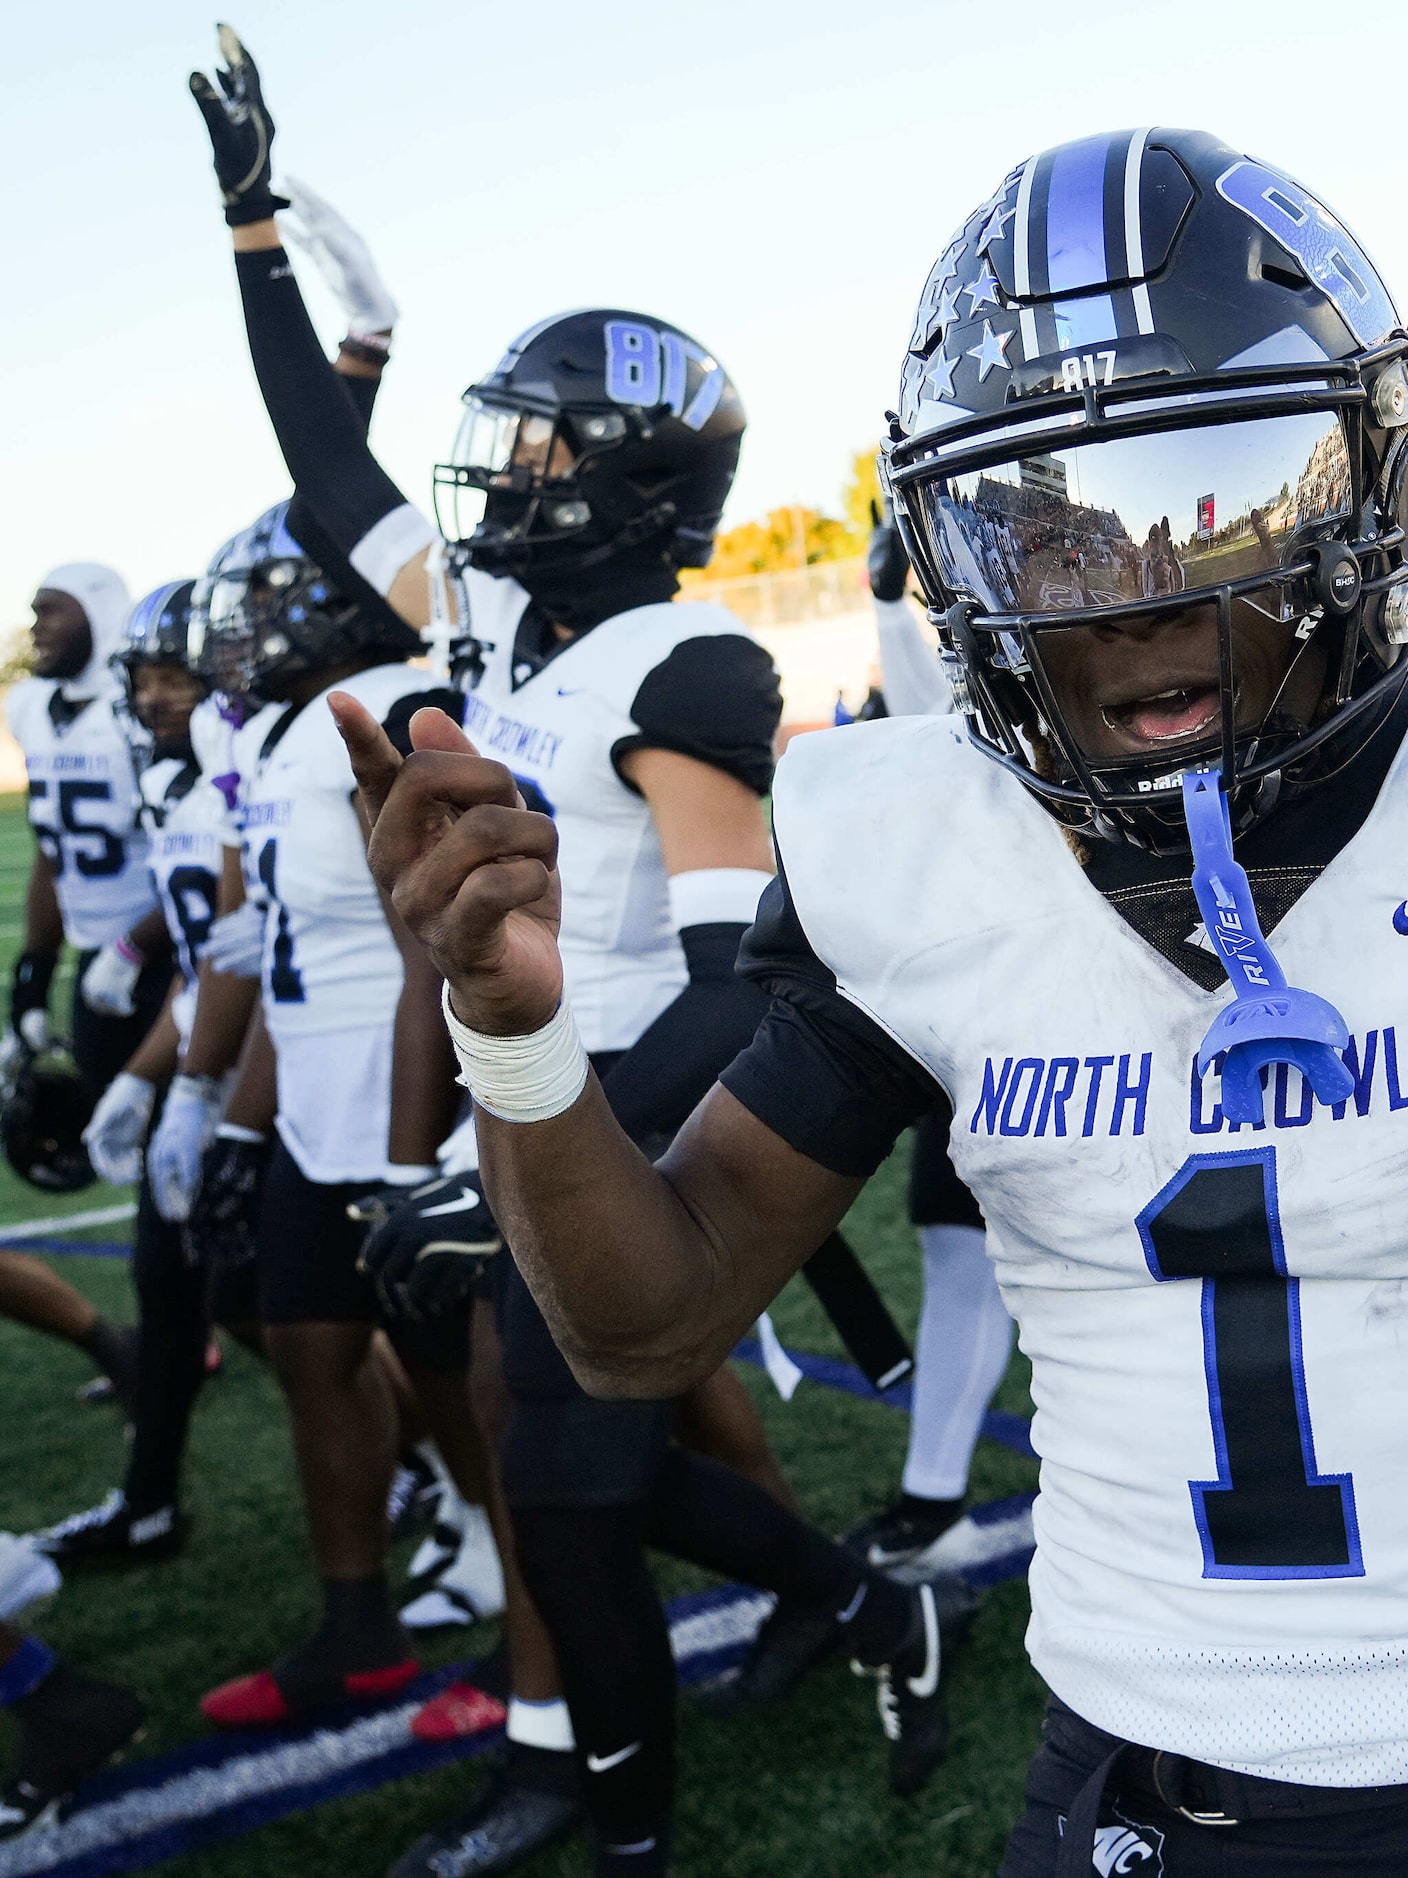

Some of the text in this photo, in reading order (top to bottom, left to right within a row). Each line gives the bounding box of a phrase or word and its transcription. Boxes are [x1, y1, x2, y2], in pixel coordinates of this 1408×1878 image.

[603, 319, 725, 432] 817
[1061, 350, 1117, 393] 817
[243, 837, 307, 1003] 1
[970, 1051, 1153, 1138] NORTH
[1134, 1145, 1367, 1581] 1
